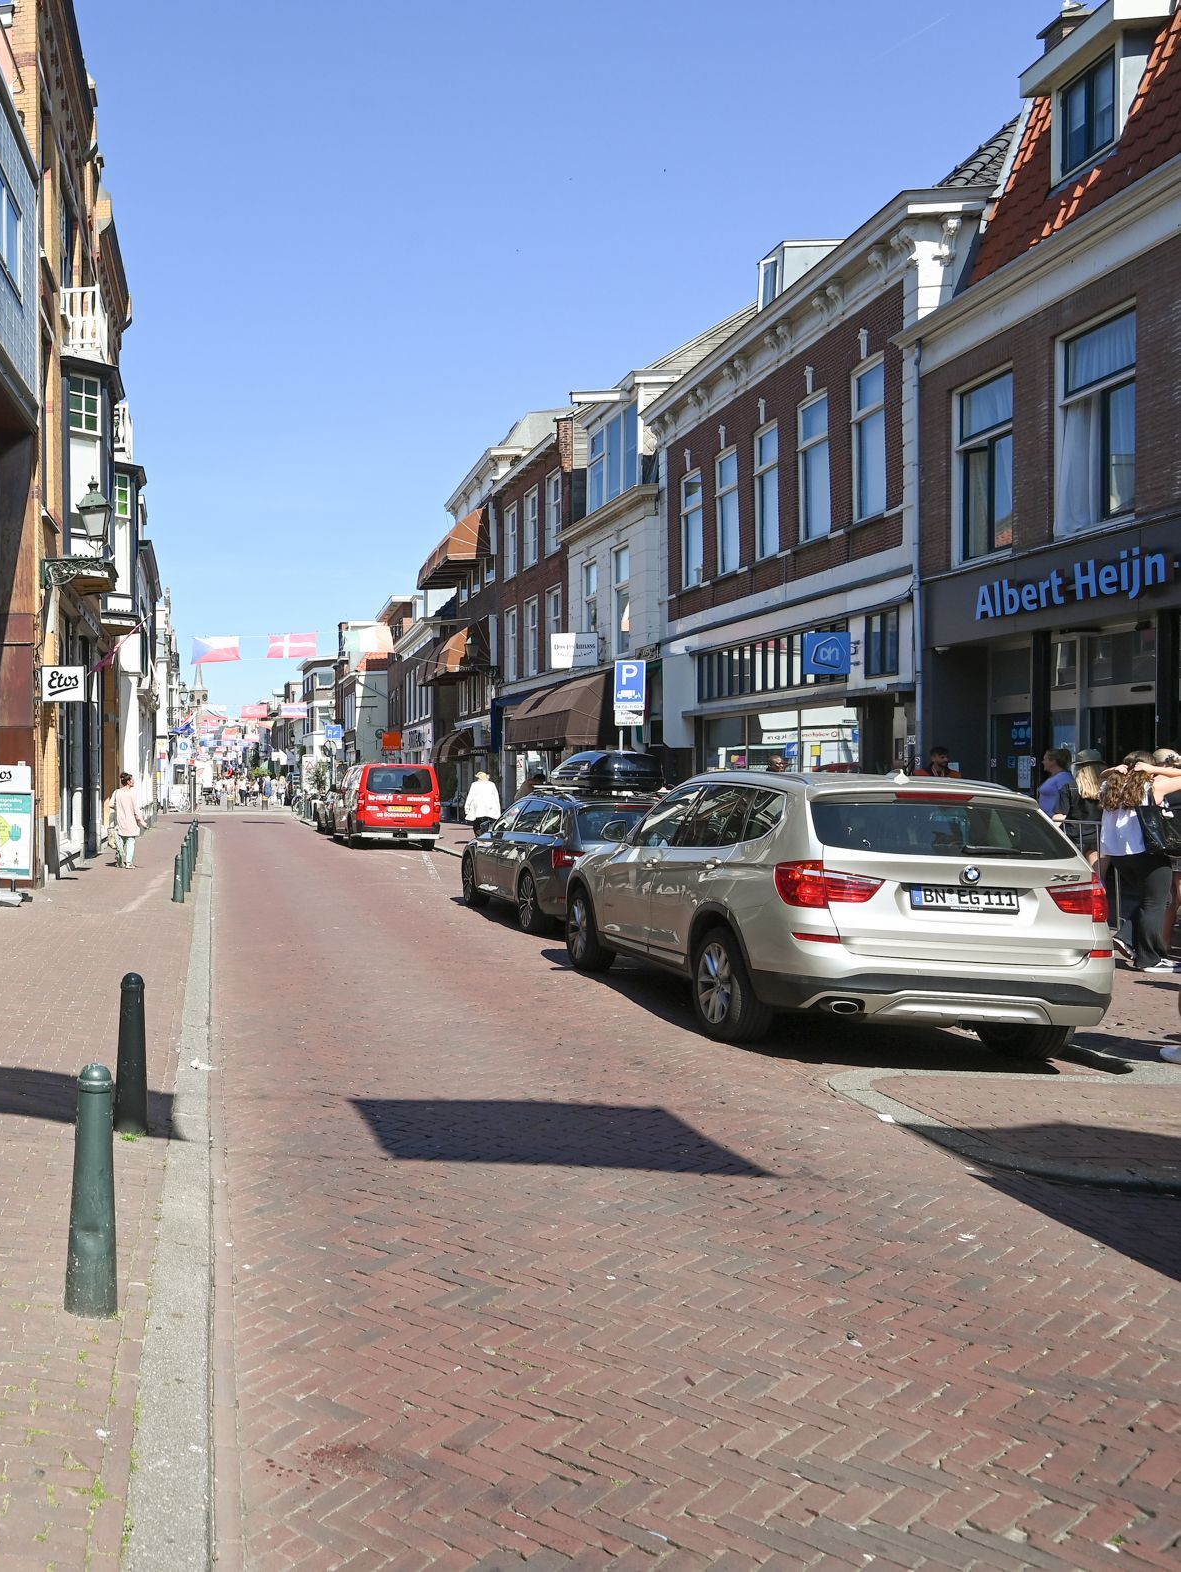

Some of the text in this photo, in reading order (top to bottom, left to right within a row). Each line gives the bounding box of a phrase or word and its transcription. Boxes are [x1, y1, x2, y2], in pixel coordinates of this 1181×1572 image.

[975, 546, 1166, 620] Albert Heijn
[48, 670, 79, 690] Etos
[622, 664, 638, 685] P
[1050, 874, 1081, 882] X3
[923, 888, 1016, 907] BN EG 111
